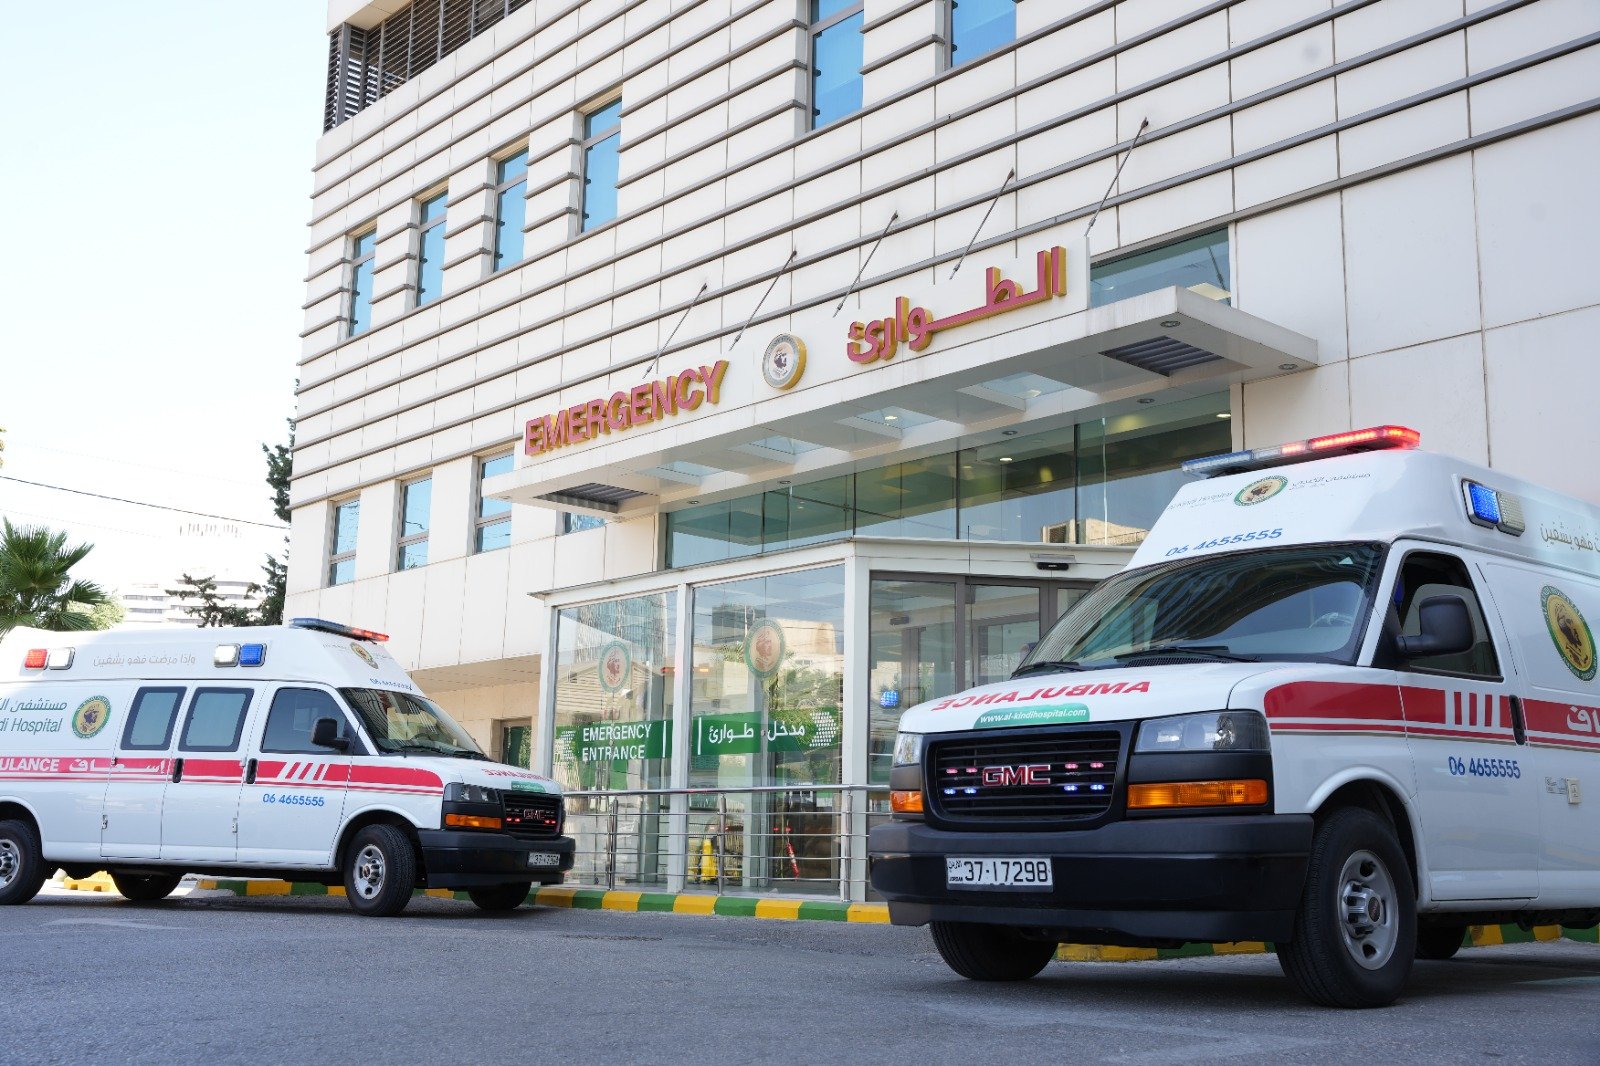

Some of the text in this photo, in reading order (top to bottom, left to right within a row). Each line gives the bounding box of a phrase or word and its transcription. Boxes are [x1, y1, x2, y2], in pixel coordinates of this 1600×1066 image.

[847, 246, 1067, 364] الطوارئ
[524, 359, 729, 456] EMERGENCY
[1165, 528, 1283, 557] 06 4655555
[10, 717, 63, 735] Hospital
[980, 708, 1087, 724] www.al-kindihospital.com
[583, 723, 652, 743] EMERGENCY
[708, 719, 806, 744] مدخل طوارئ
[582, 744, 646, 762] ENTRANCE
[0, 757, 60, 772] ULANCE
[1448, 756, 1521, 779] 06 4655555
[982, 764, 1051, 787] GMC
[262, 793, 325, 807] 06 4655555
